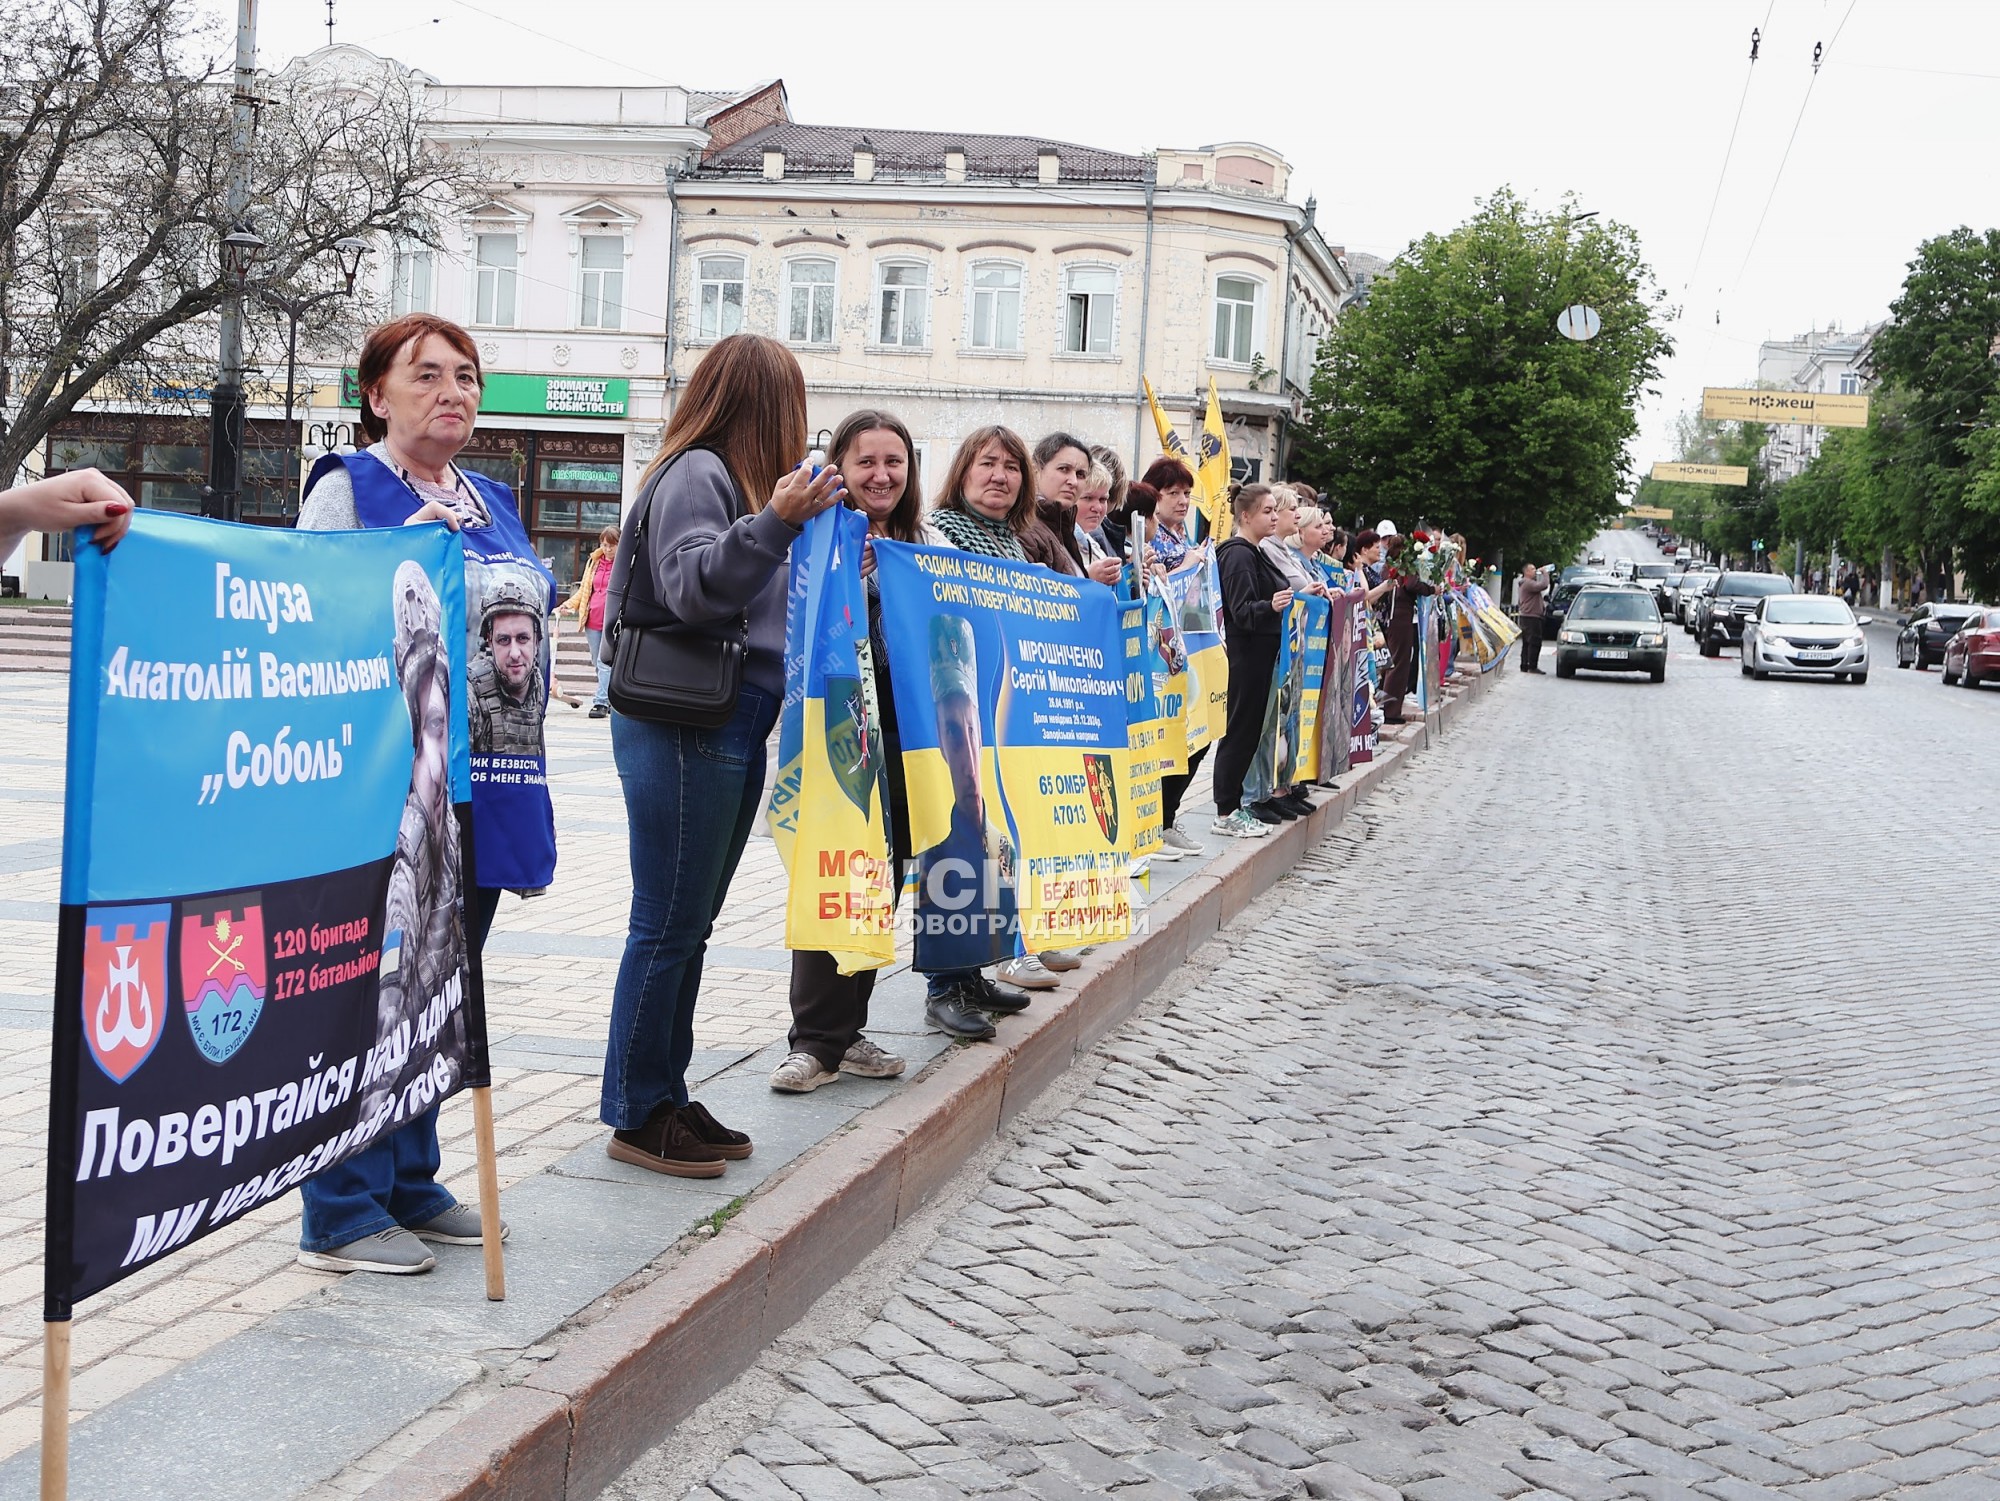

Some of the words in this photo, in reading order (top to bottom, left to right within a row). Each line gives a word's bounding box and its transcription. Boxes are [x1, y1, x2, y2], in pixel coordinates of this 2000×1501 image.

[546, 380, 608, 392] ЗООМАРКЕТ
[546, 390, 604, 402] ХВОСТАТИХ
[546, 400, 624, 414] ОСОБИСТОСТЕЙ
[914, 553, 964, 579] РОДИНА
[964, 560, 996, 585] ЧЕКАЄ
[996, 568, 1011, 589] НА
[1010, 570, 1043, 594] СВОГО
[1043, 578, 1081, 599] ГЕРОЯ!
[215, 562, 313, 633] Галуза
[932, 581, 974, 608] СИНКУ,
[971, 587, 1034, 616] ПОВЕРТАЙСЯ
[1034, 600, 1081, 622] ДОДОМУ!
[1018, 639, 1104, 670] МІРОШНІЧЕНКО
[107, 647, 252, 700] Анатолій
[259, 651, 391, 699] Васильович
[1011, 666, 1047, 695] Сергій
[1047, 669, 1125, 696] Миколайович
[490, 773, 521, 784] МЕНЕ
[492, 758, 539, 771] БЕЗВІСТИ,
[1039, 775, 1053, 796] 65
[1055, 774, 1087, 795] ОМБР
[1053, 805, 1087, 826] А7013
[1099, 852, 1110, 872] ДЕ
[1110, 851, 1123, 869] ТИ
[1043, 878, 1103, 902] БЕЗВІСТИ
[1042, 911, 1057, 931] НЕ
[274, 929, 306, 960] 120
[310, 915, 369, 956] бригада
[275, 970, 305, 1001] 172
[309, 946, 379, 995] батальйон
[211, 1010, 242, 1036] 172
[224, 1026, 249, 1056] БУДЕМ
[76, 1052, 358, 1182] Повертайся
[356, 1019, 411, 1093] наш
[120, 1198, 208, 1268] ми
